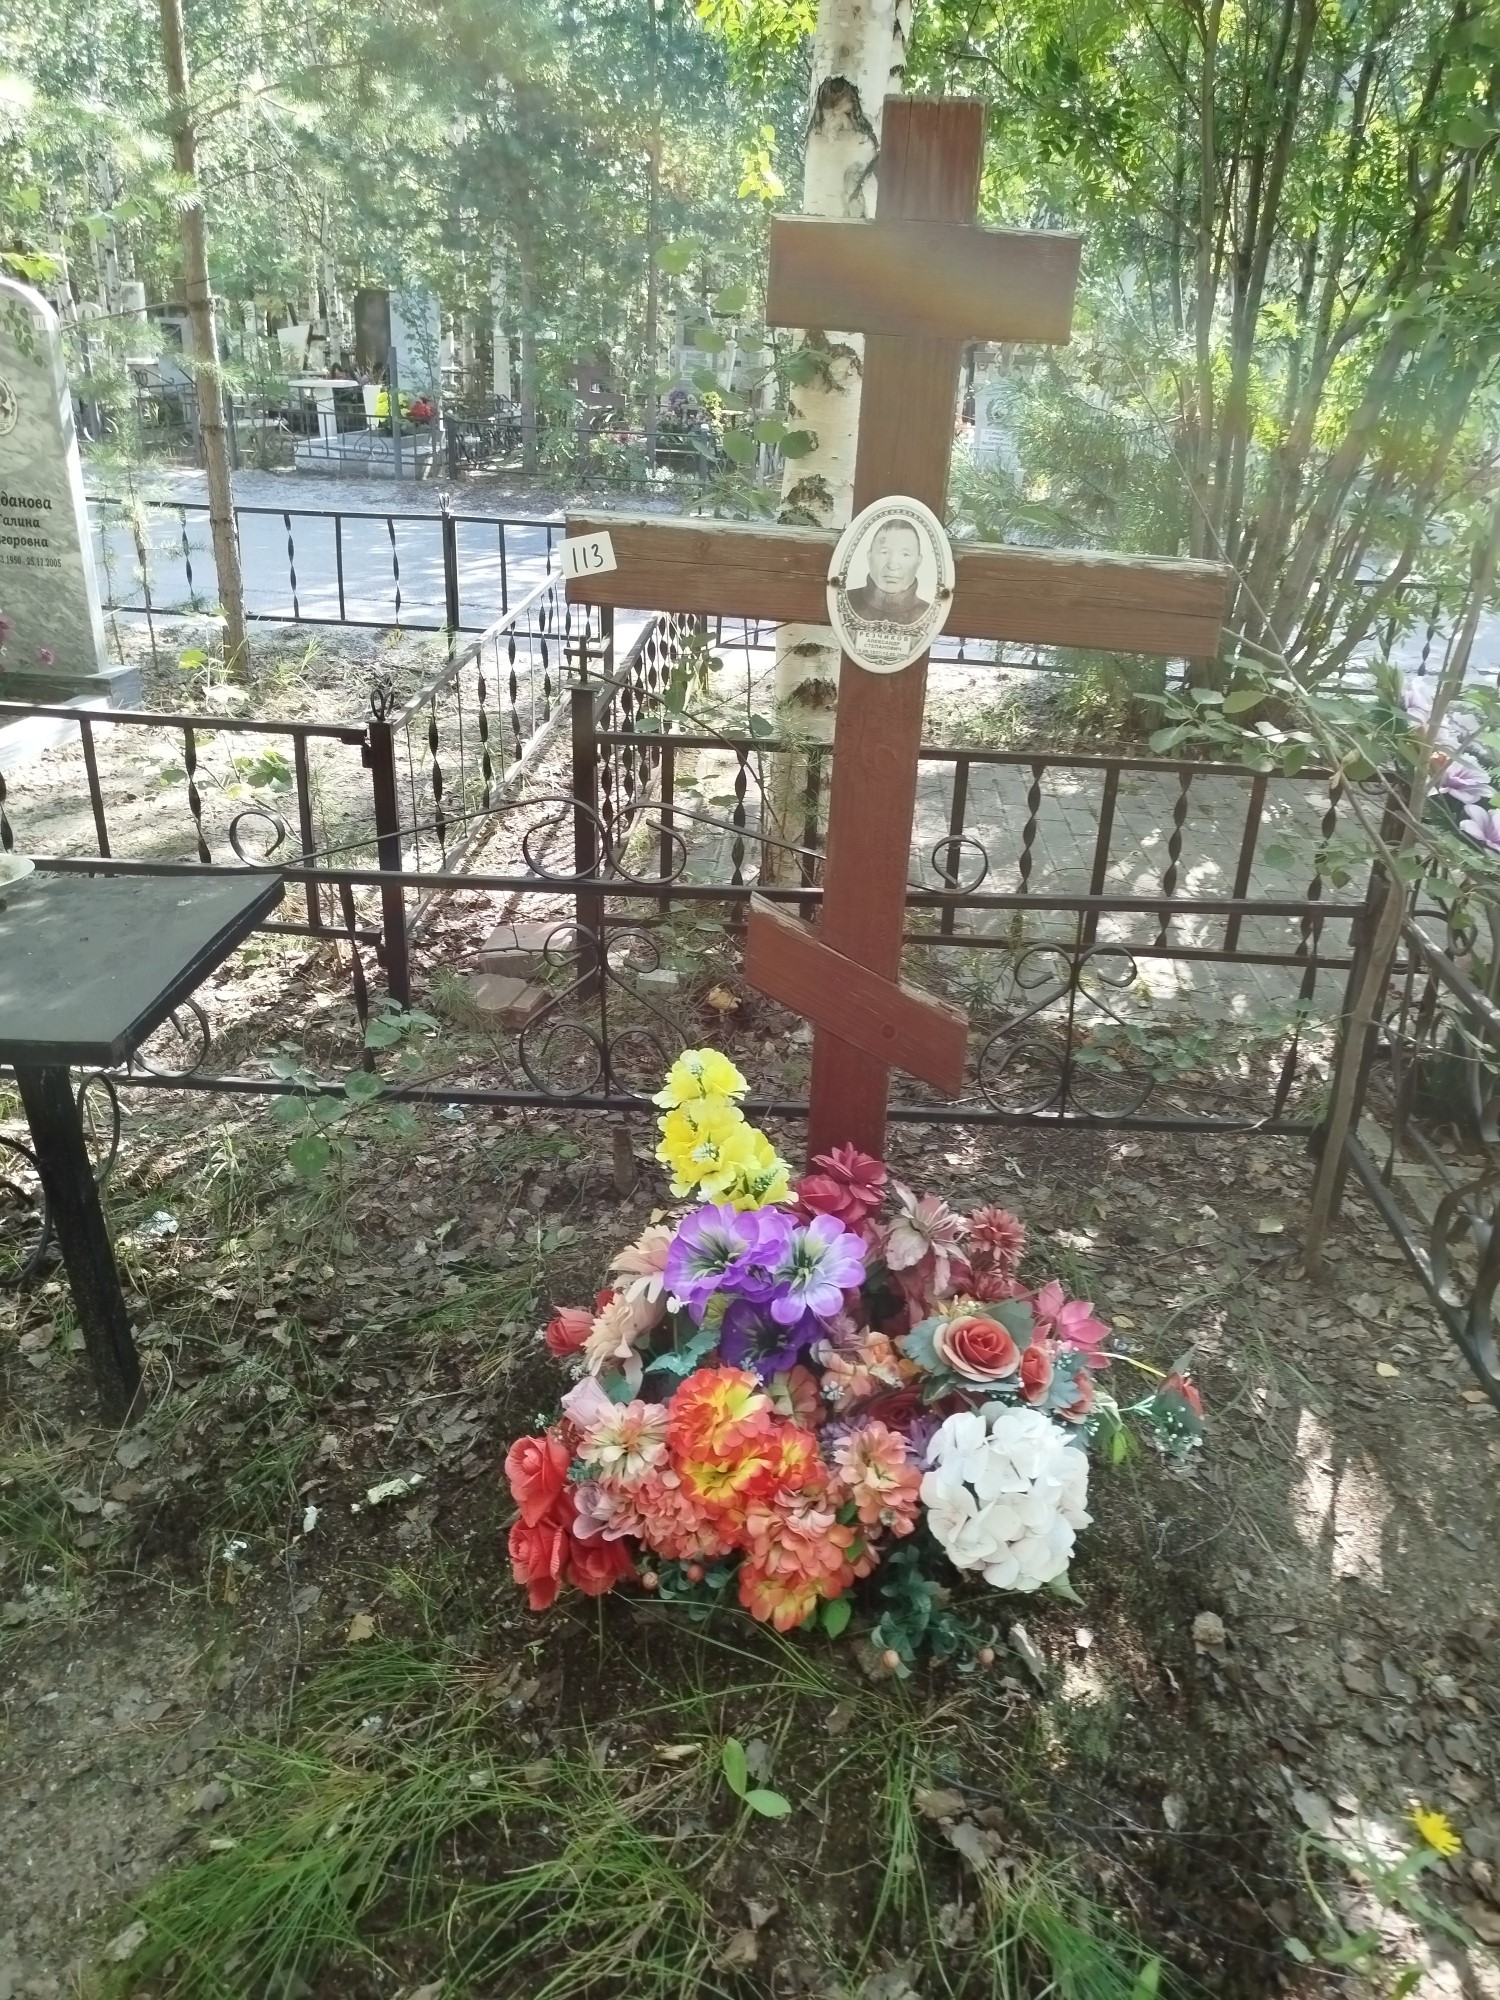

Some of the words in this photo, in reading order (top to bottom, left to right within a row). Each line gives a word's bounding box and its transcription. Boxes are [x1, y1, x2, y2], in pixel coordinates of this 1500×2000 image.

[0, 513, 40, 528] алина
[0, 534, 49, 549] горовна
[572, 543, 604, 573] 113
[859, 631, 908, 641] РЕЗЧИКОВ
[863, 643, 902, 651] СТЕПАНОВИЧ
